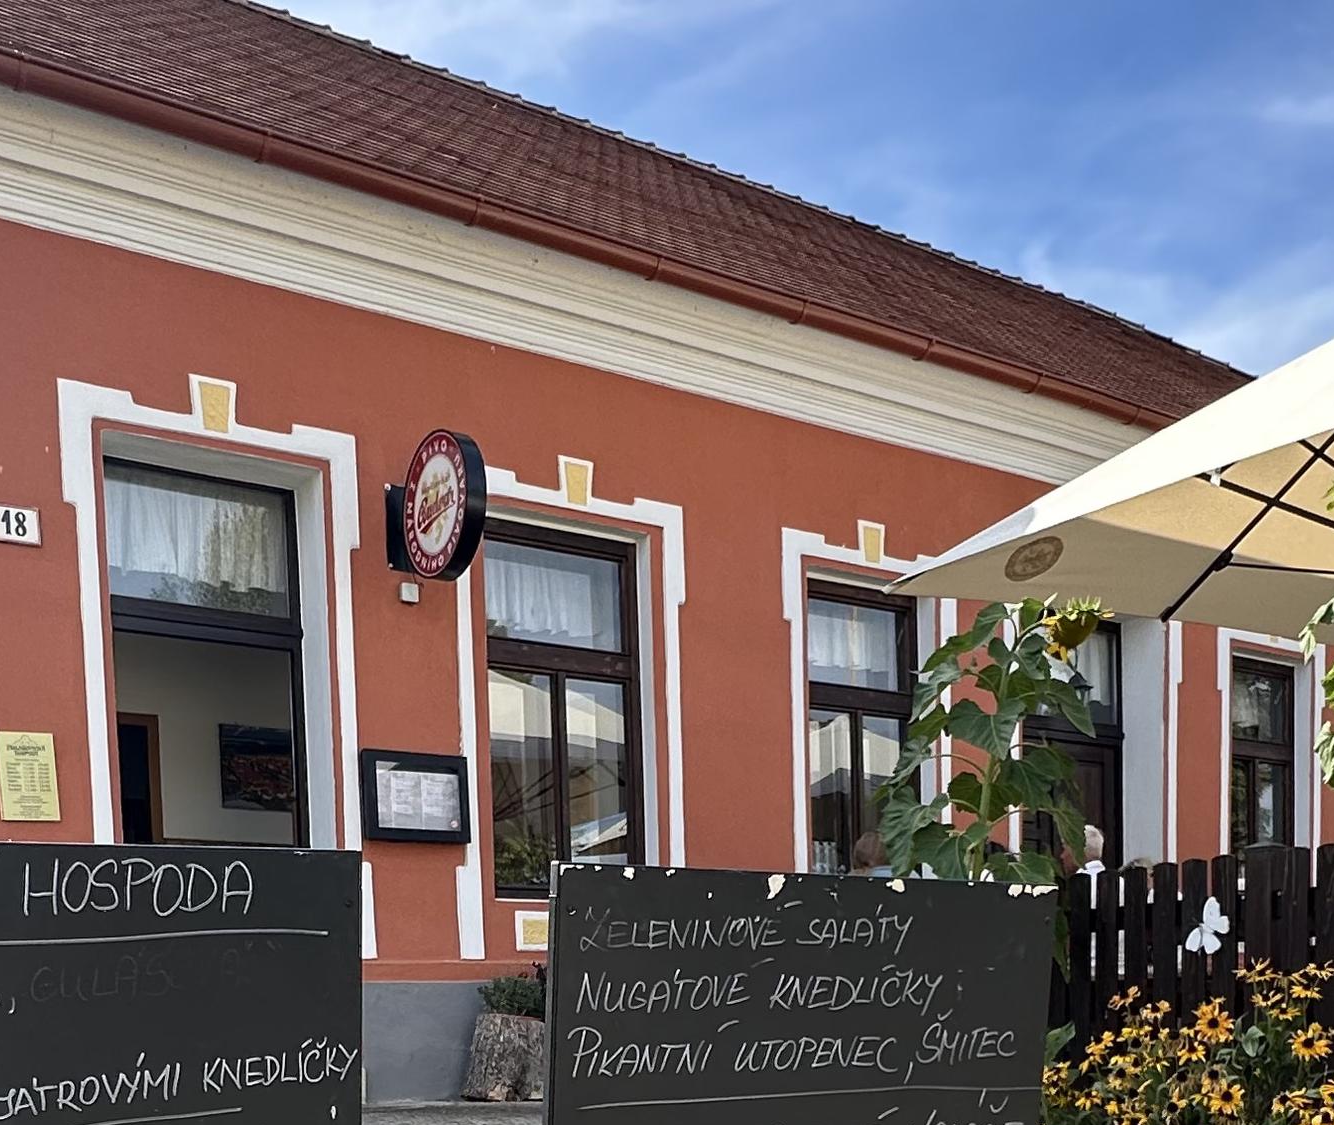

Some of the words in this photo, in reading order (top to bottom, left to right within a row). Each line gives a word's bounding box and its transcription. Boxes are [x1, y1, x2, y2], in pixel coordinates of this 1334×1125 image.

[421, 439, 448, 463] PIVO
[0, 509, 28, 537] 18
[22, 859, 257, 918] HOSPODA
[796, 904, 913, 954] SALÁTY
[575, 957, 775, 1013] NUGÁTOVÉ
[202, 1034, 359, 1096] KNEDLÍČKY
[567, 1020, 739, 1078] PIKANTNÍ
[733, 1036, 913, 1084] UTOPENEC,
[914, 1008, 1017, 1066] ŠMITEC
